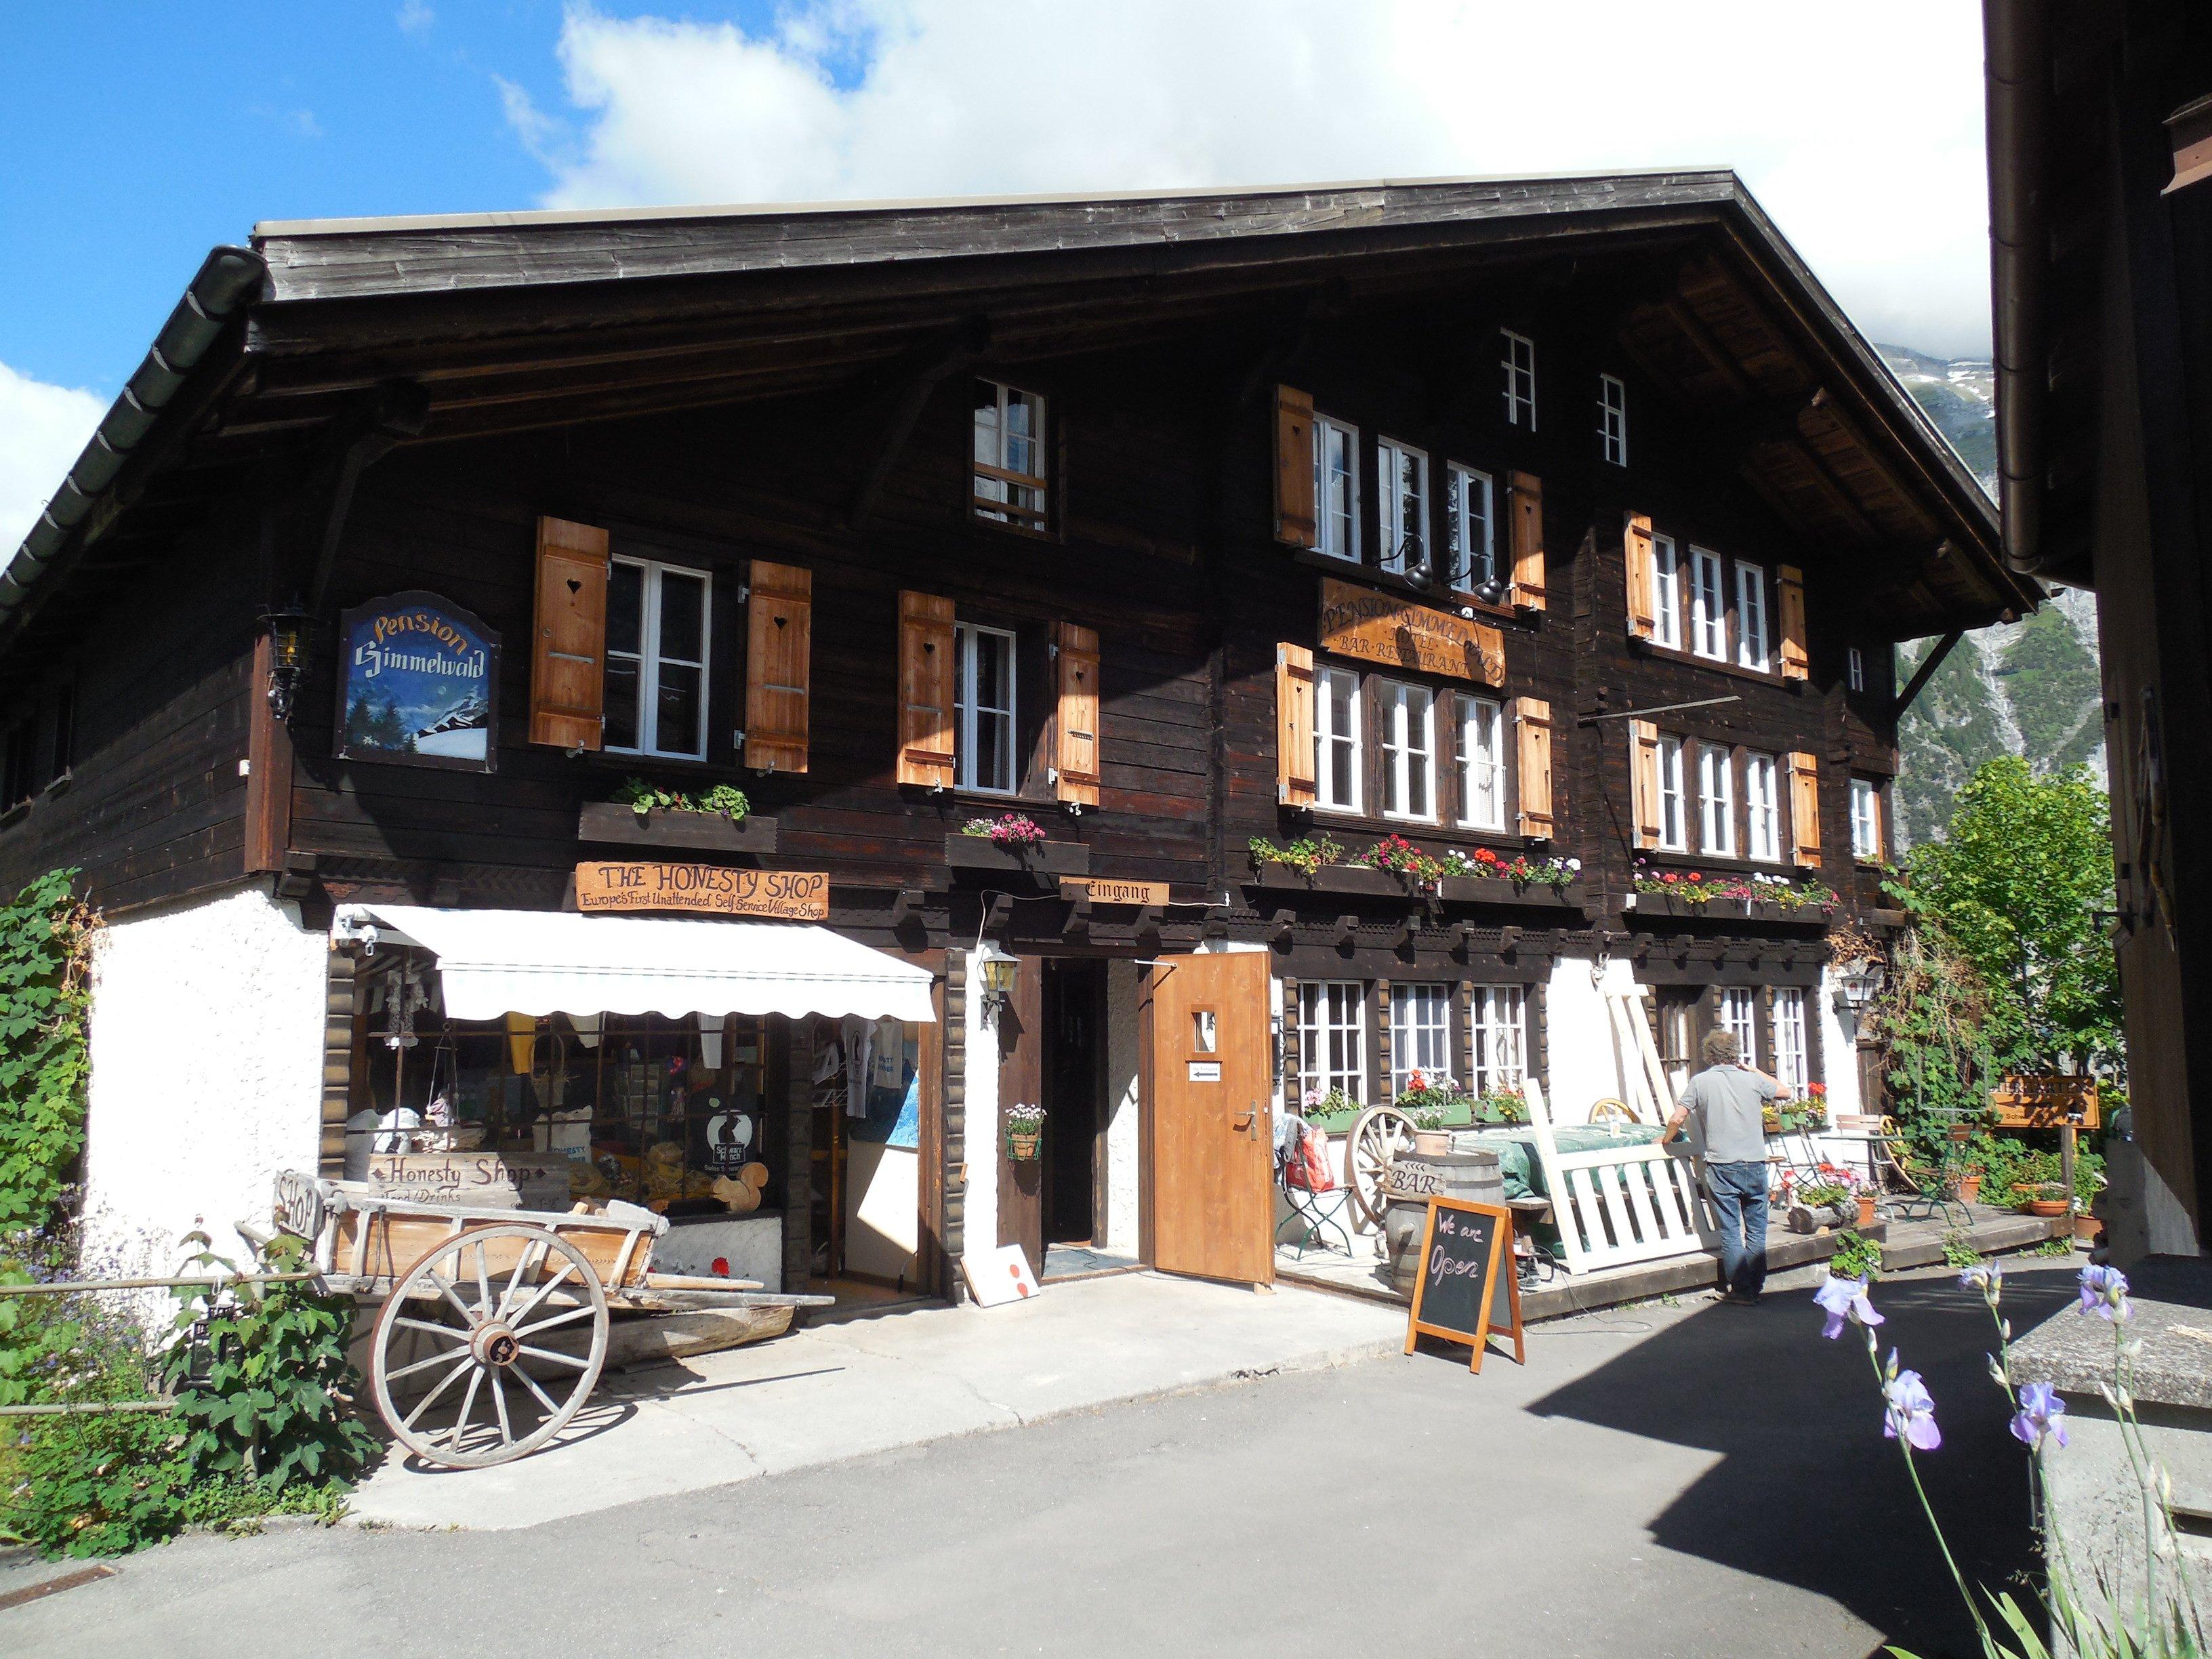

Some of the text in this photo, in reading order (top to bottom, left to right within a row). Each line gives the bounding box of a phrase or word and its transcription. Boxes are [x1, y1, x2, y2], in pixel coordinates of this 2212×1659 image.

[1323, 598, 1401, 632] PENSION
[354, 640, 485, 678] Gimmelwald
[598, 865, 823, 899] THE HONESTY SHOP
[1085, 880, 1150, 903] Eingang
[580, 890, 825, 920] Europe's First Unattended Self Service Village Shop
[720, 1153, 741, 1162] Mnch
[380, 1158, 531, 1191] Honesty Shop
[1391, 1170, 1437, 1195] BAR
[279, 1175, 313, 1233] SHOP
[1438, 1212, 1483, 1243] We are
[1430, 1244, 1479, 1286] Open
